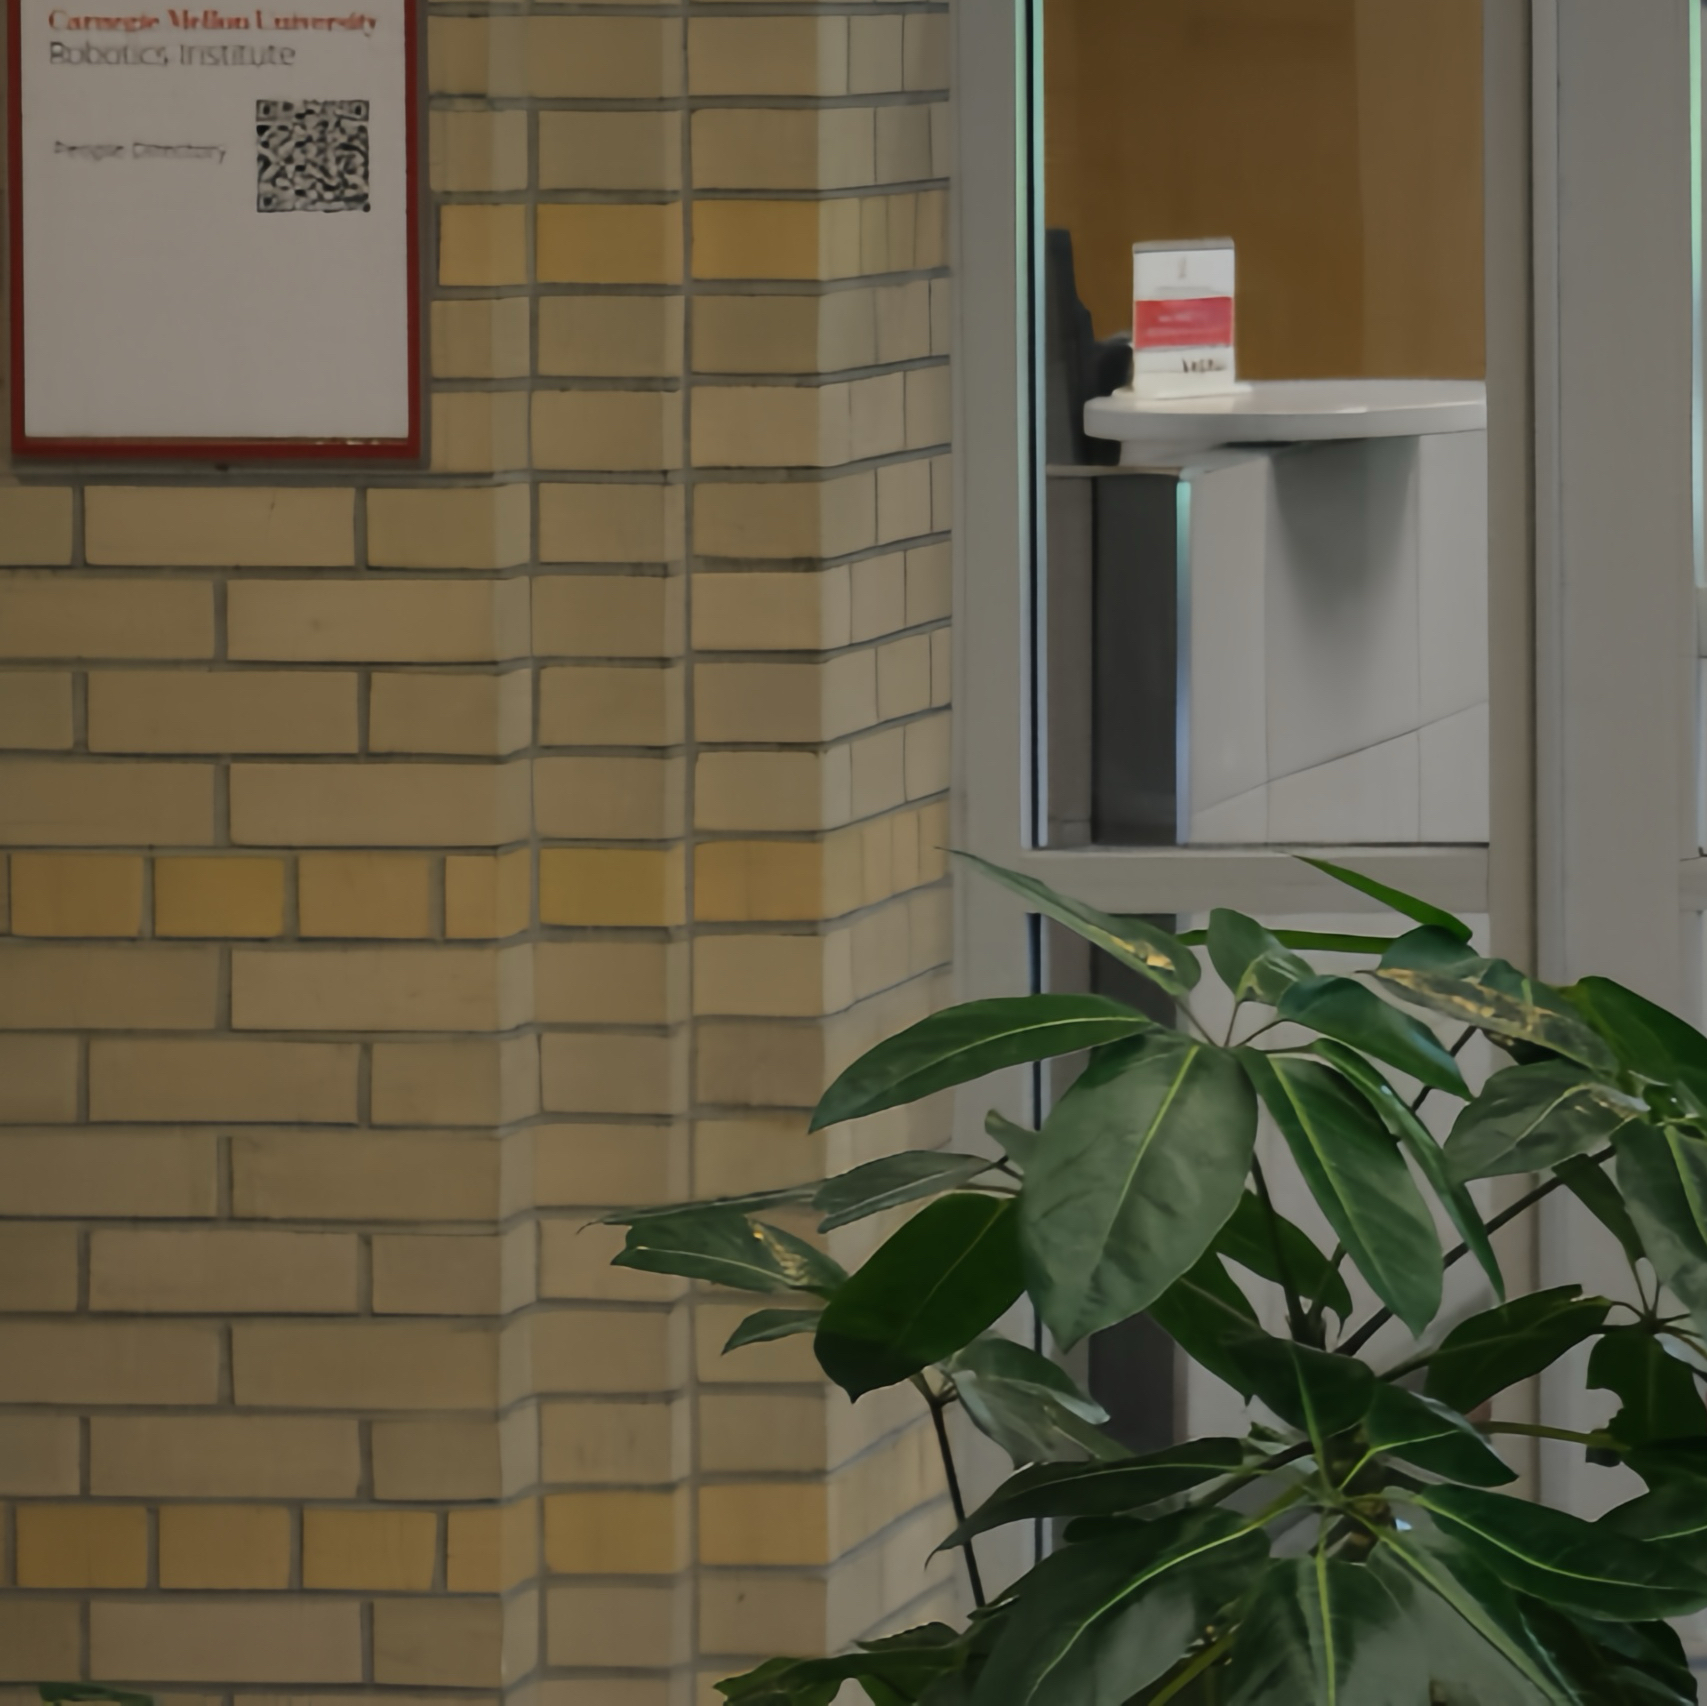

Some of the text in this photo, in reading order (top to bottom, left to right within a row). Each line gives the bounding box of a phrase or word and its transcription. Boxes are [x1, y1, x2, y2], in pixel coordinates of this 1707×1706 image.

[48, 9, 160, 32] Carnegie
[50, 42, 296, 67] Robotics Institute
